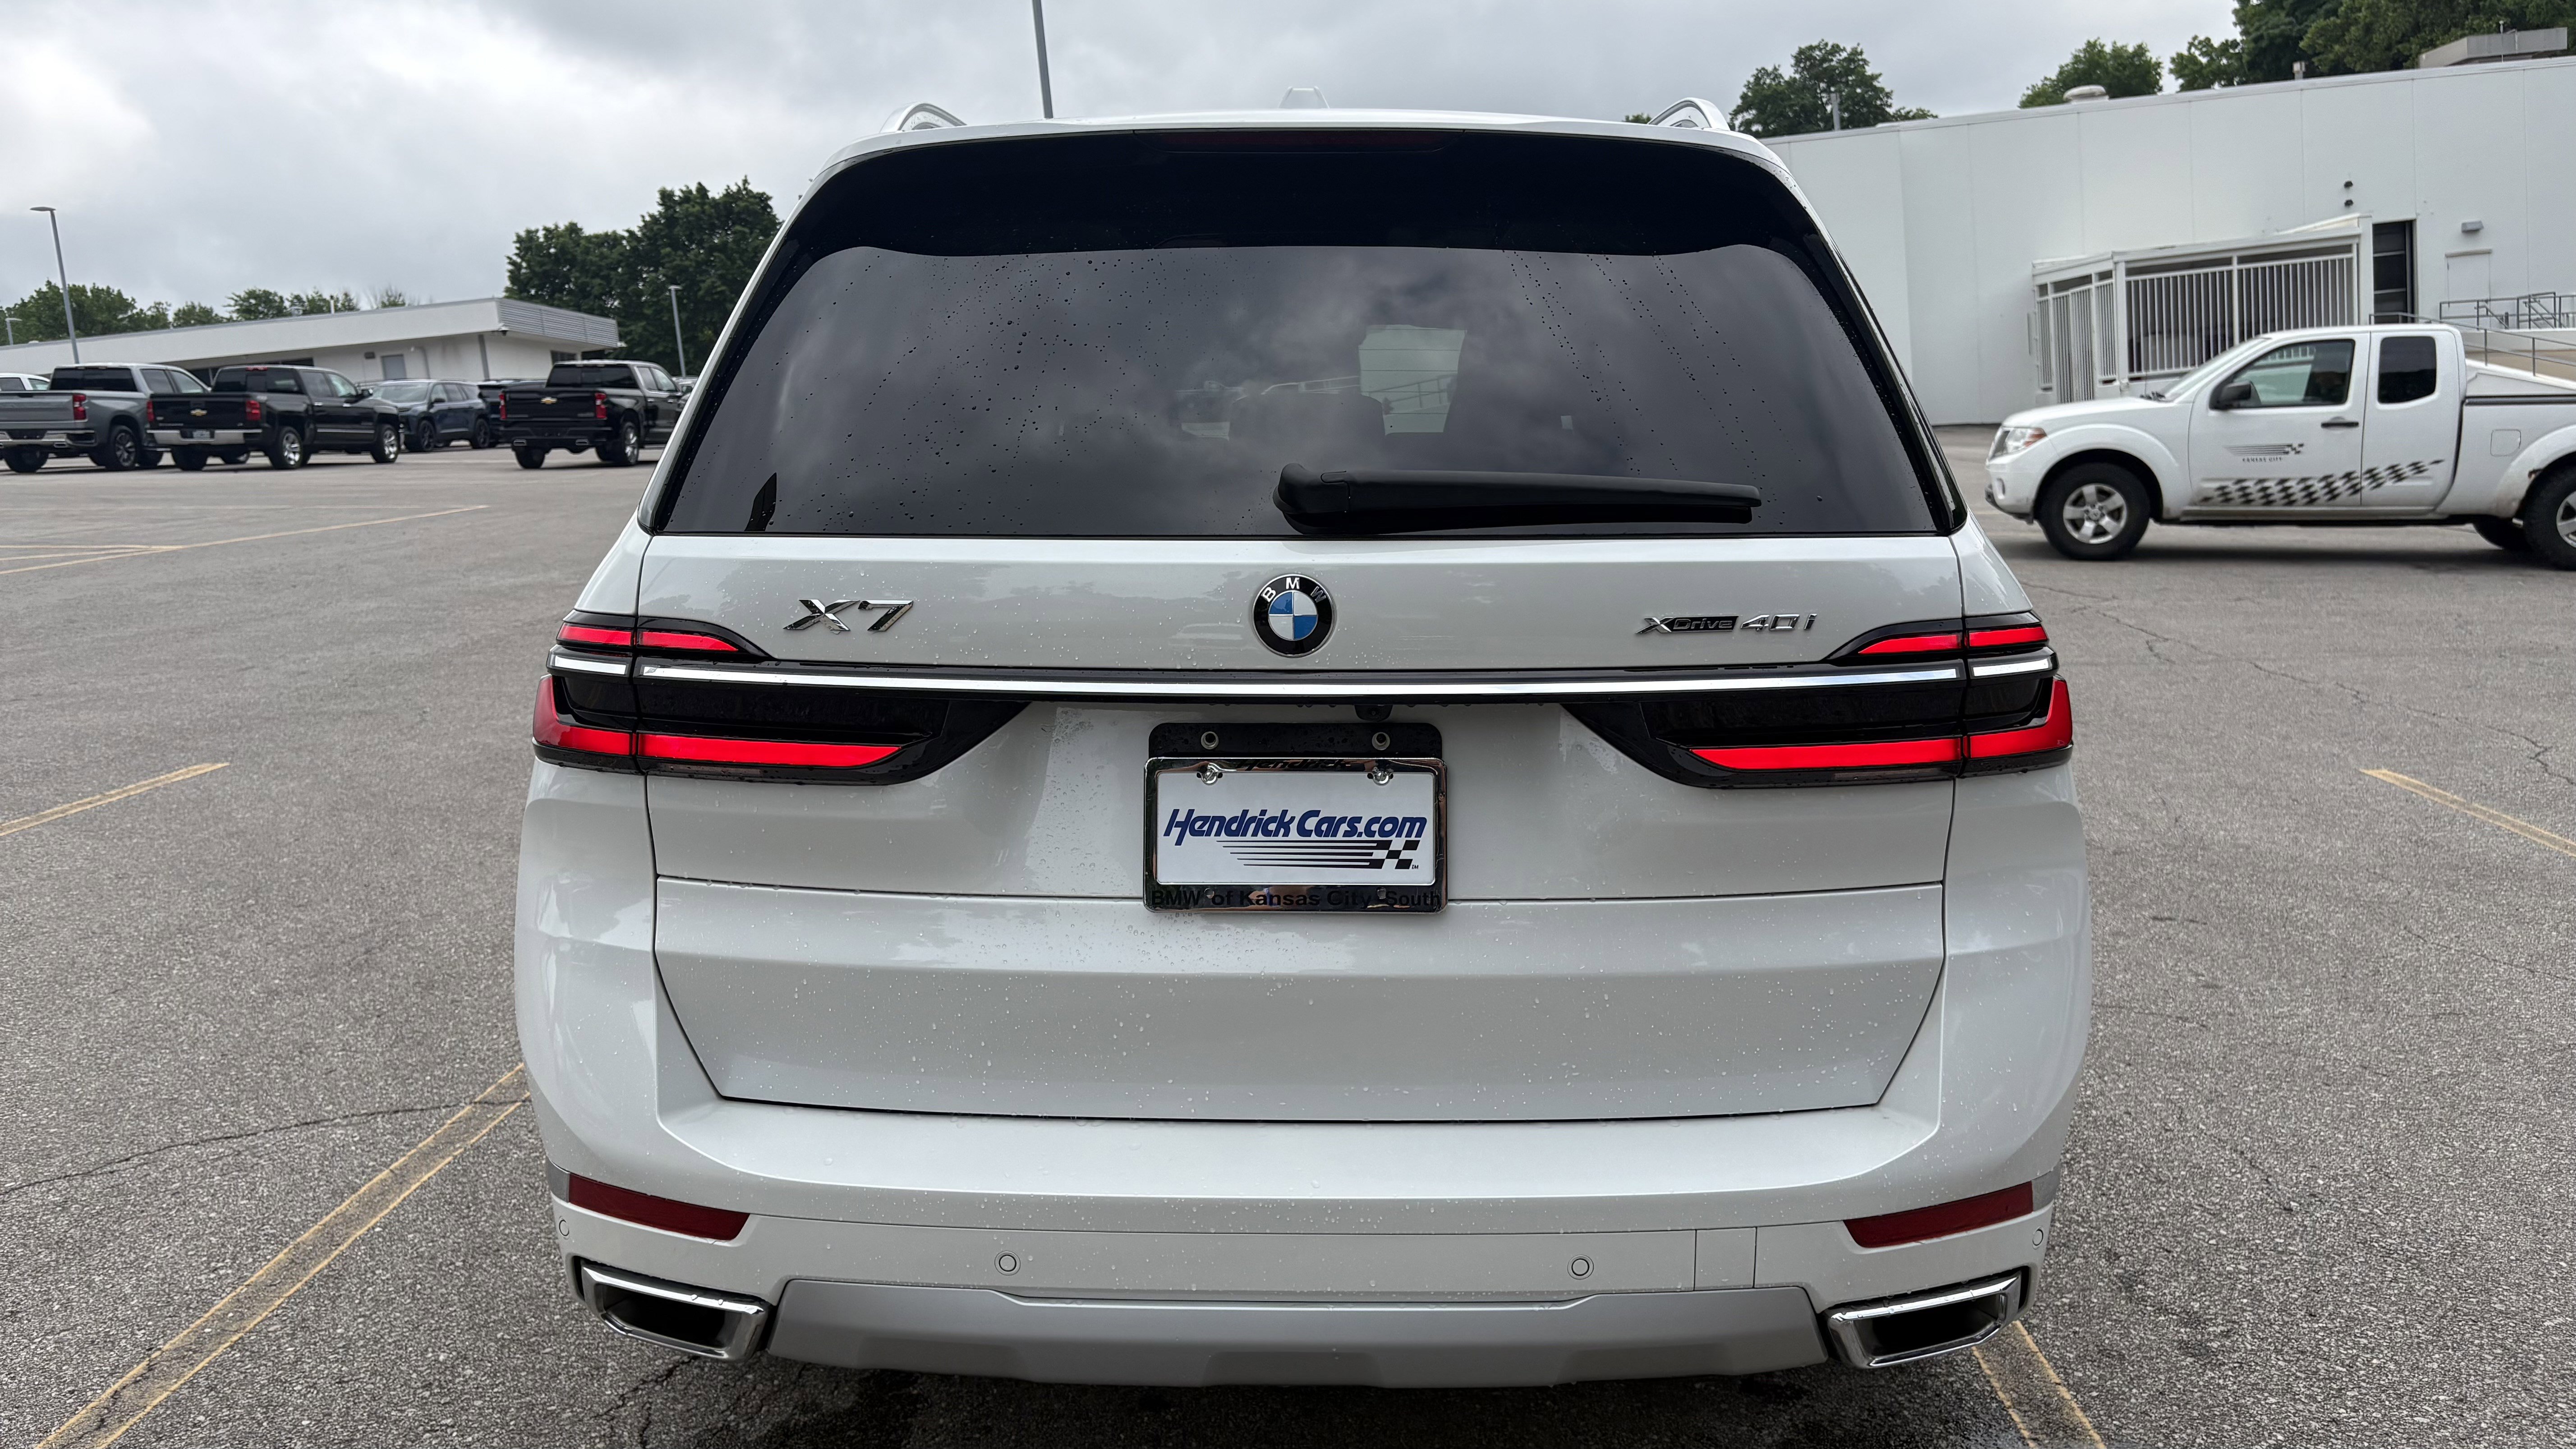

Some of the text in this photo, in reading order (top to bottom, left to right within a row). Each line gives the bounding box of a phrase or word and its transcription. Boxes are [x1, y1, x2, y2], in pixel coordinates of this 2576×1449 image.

[1261, 577, 1326, 603] BMW
[782, 599, 914, 631] X7
[1151, 890, 1200, 906] BMW
[1211, 890, 1233, 905] of
[1240, 890, 1320, 906] Kansas
[1327, 890, 1371, 909] City
